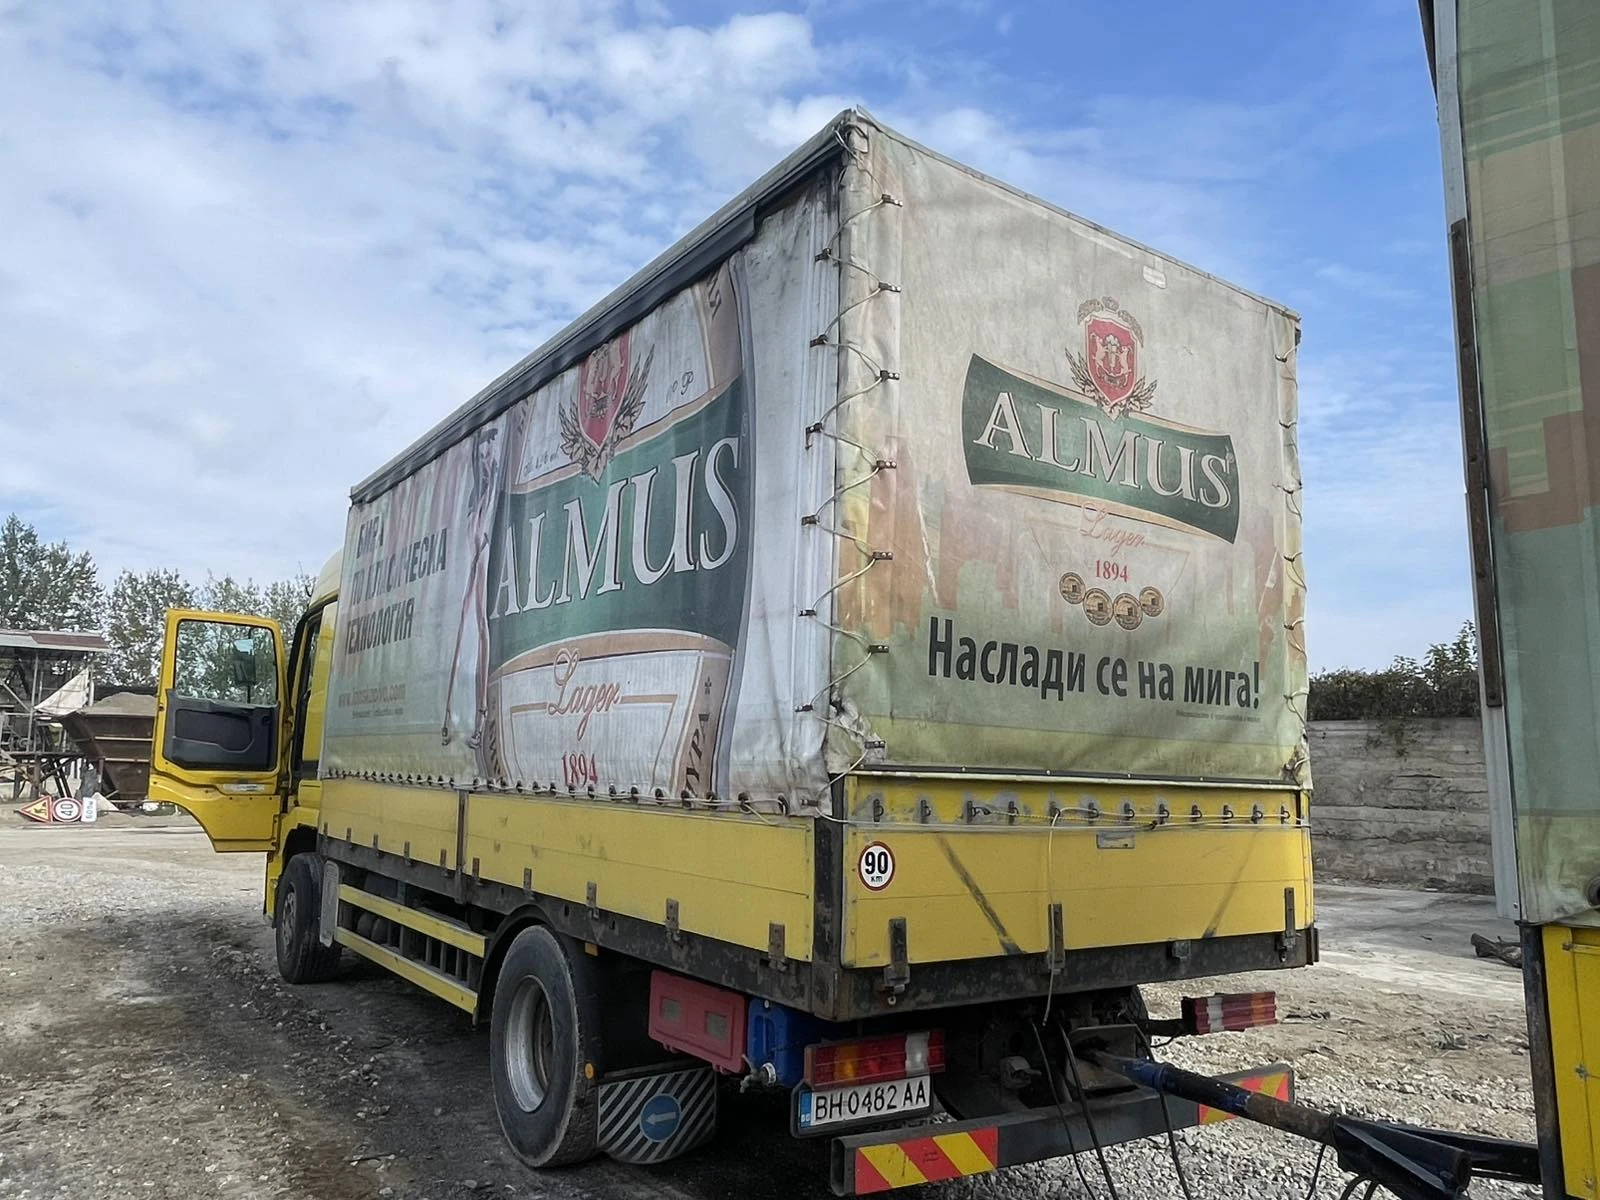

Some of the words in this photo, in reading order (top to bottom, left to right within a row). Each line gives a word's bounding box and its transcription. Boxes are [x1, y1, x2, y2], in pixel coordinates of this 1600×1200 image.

[973, 391, 1231, 508] ALMUS
[490, 436, 740, 620] ALMUS
[1080, 503, 1145, 557] Lager
[1096, 560, 1128, 583] 1894
[346, 597, 414, 654] ТЕХНОЛОГИЯ
[928, 617, 1085, 700] Наслади
[1096, 656, 1128, 697] се
[1138, 661, 1174, 700] на
[1183, 661, 1260, 709] мига!
[548, 649, 622, 741] Lager
[562, 752, 598, 787] 1894
[60, 803, 74, 816] 40
[865, 851, 888, 875] 90
